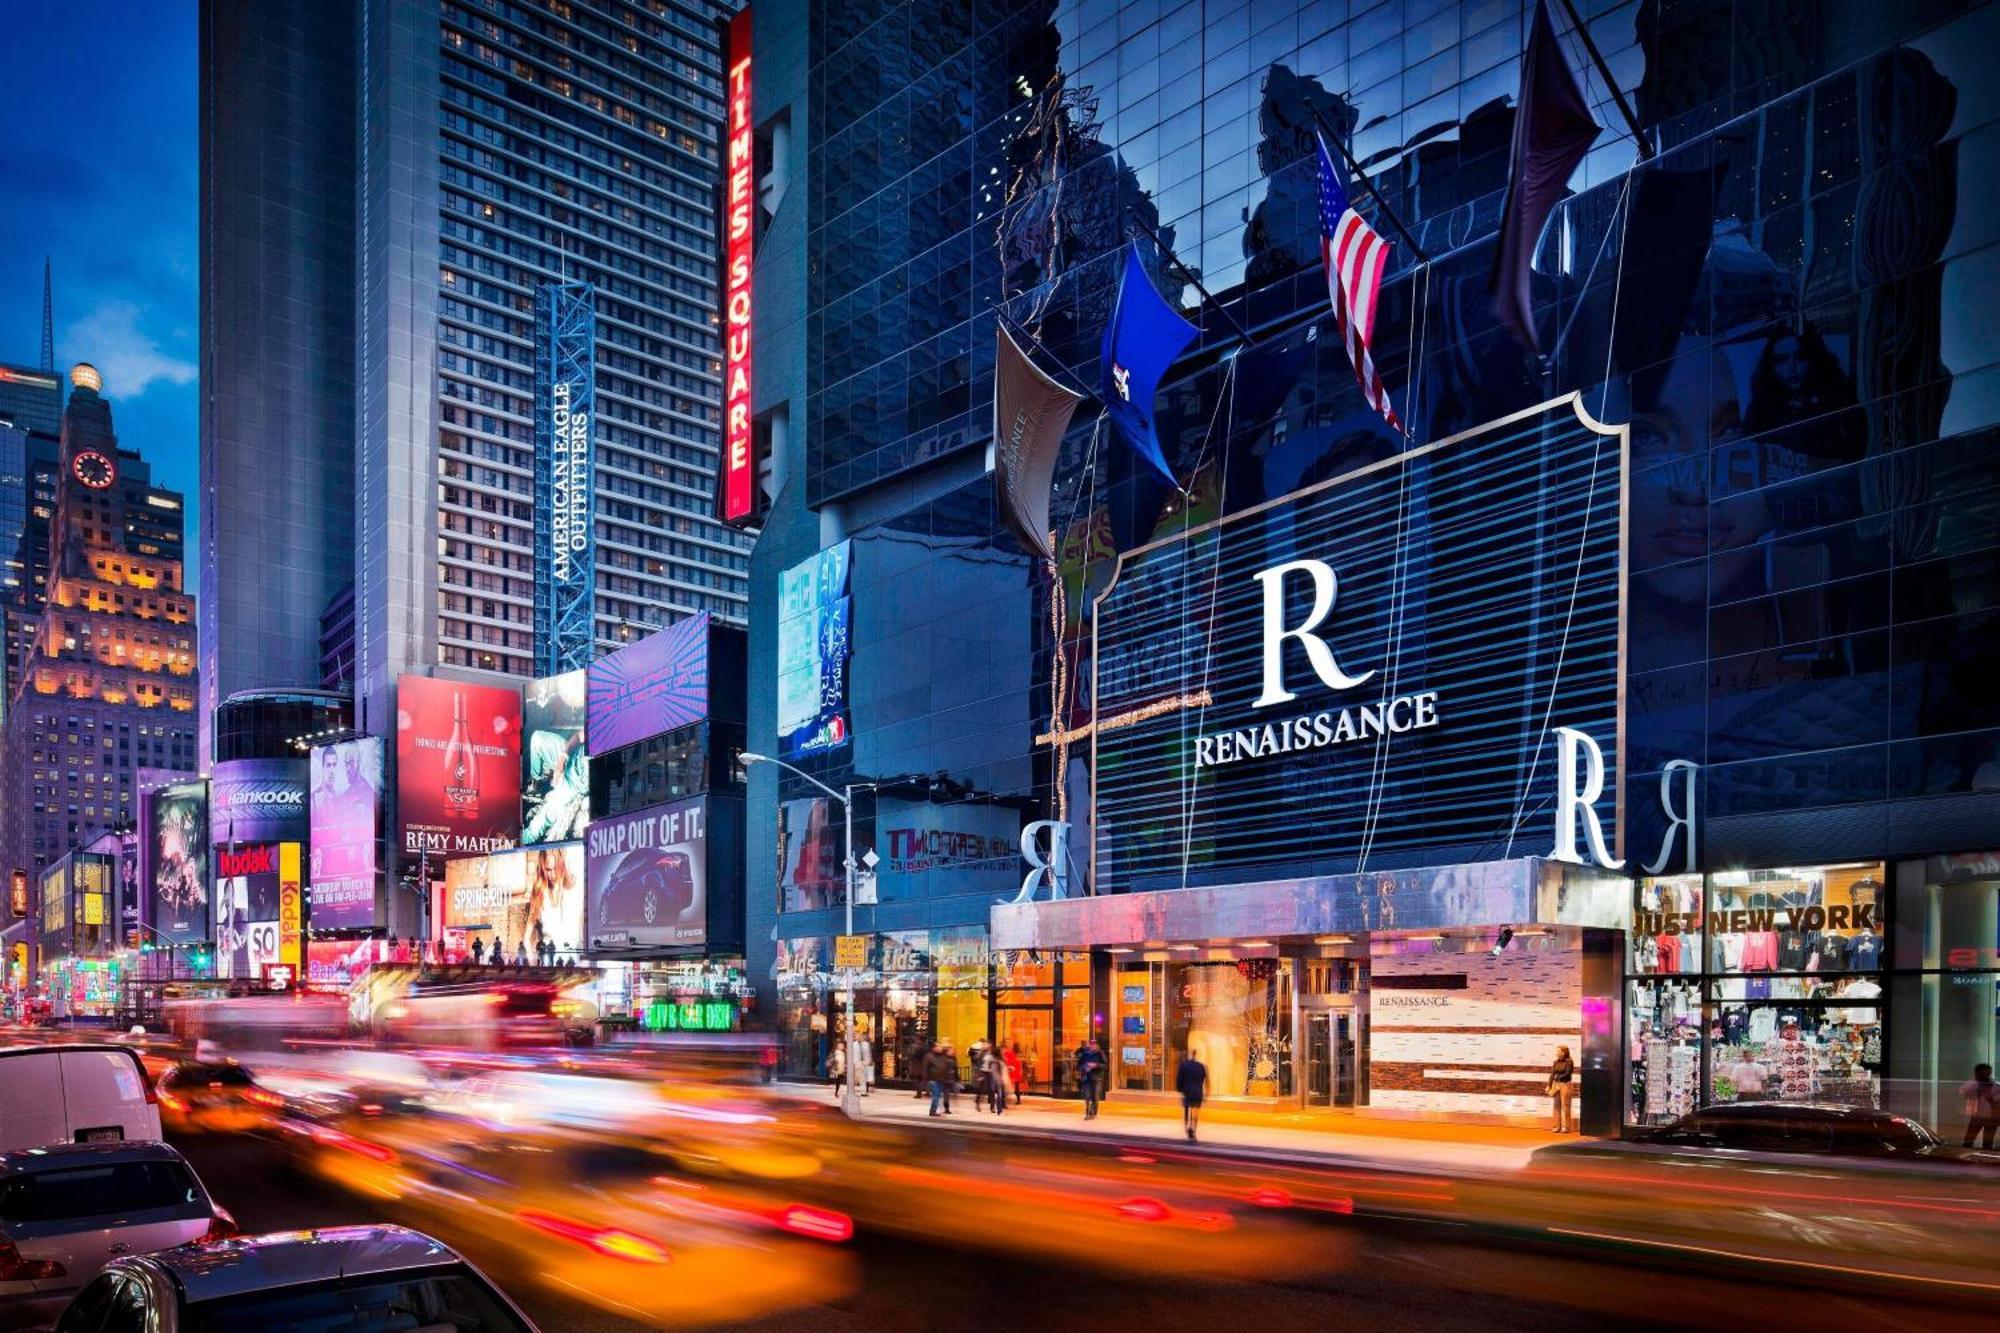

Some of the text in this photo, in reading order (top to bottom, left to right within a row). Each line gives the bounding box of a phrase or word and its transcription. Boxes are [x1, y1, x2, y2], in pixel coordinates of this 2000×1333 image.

[728, 57, 752, 472] TIMES SQUARE
[553, 383, 569, 582] AMERICAN EAGLE
[571, 412, 588, 550] OUTFITTERS
[1253, 558, 1378, 709] R
[1194, 691, 1439, 769] RENAISSANCE
[590, 806, 704, 858] SNAP OUT OF IT.
[1550, 726, 1626, 870] R
[455, 835, 514, 853] MARTIN
[281, 880, 298, 945] Kodak
[454, 887, 489, 911] SPRING
[1633, 902, 1878, 936] JUST NEW YORK
[1379, 996, 1449, 1007] RENAISSANCE
